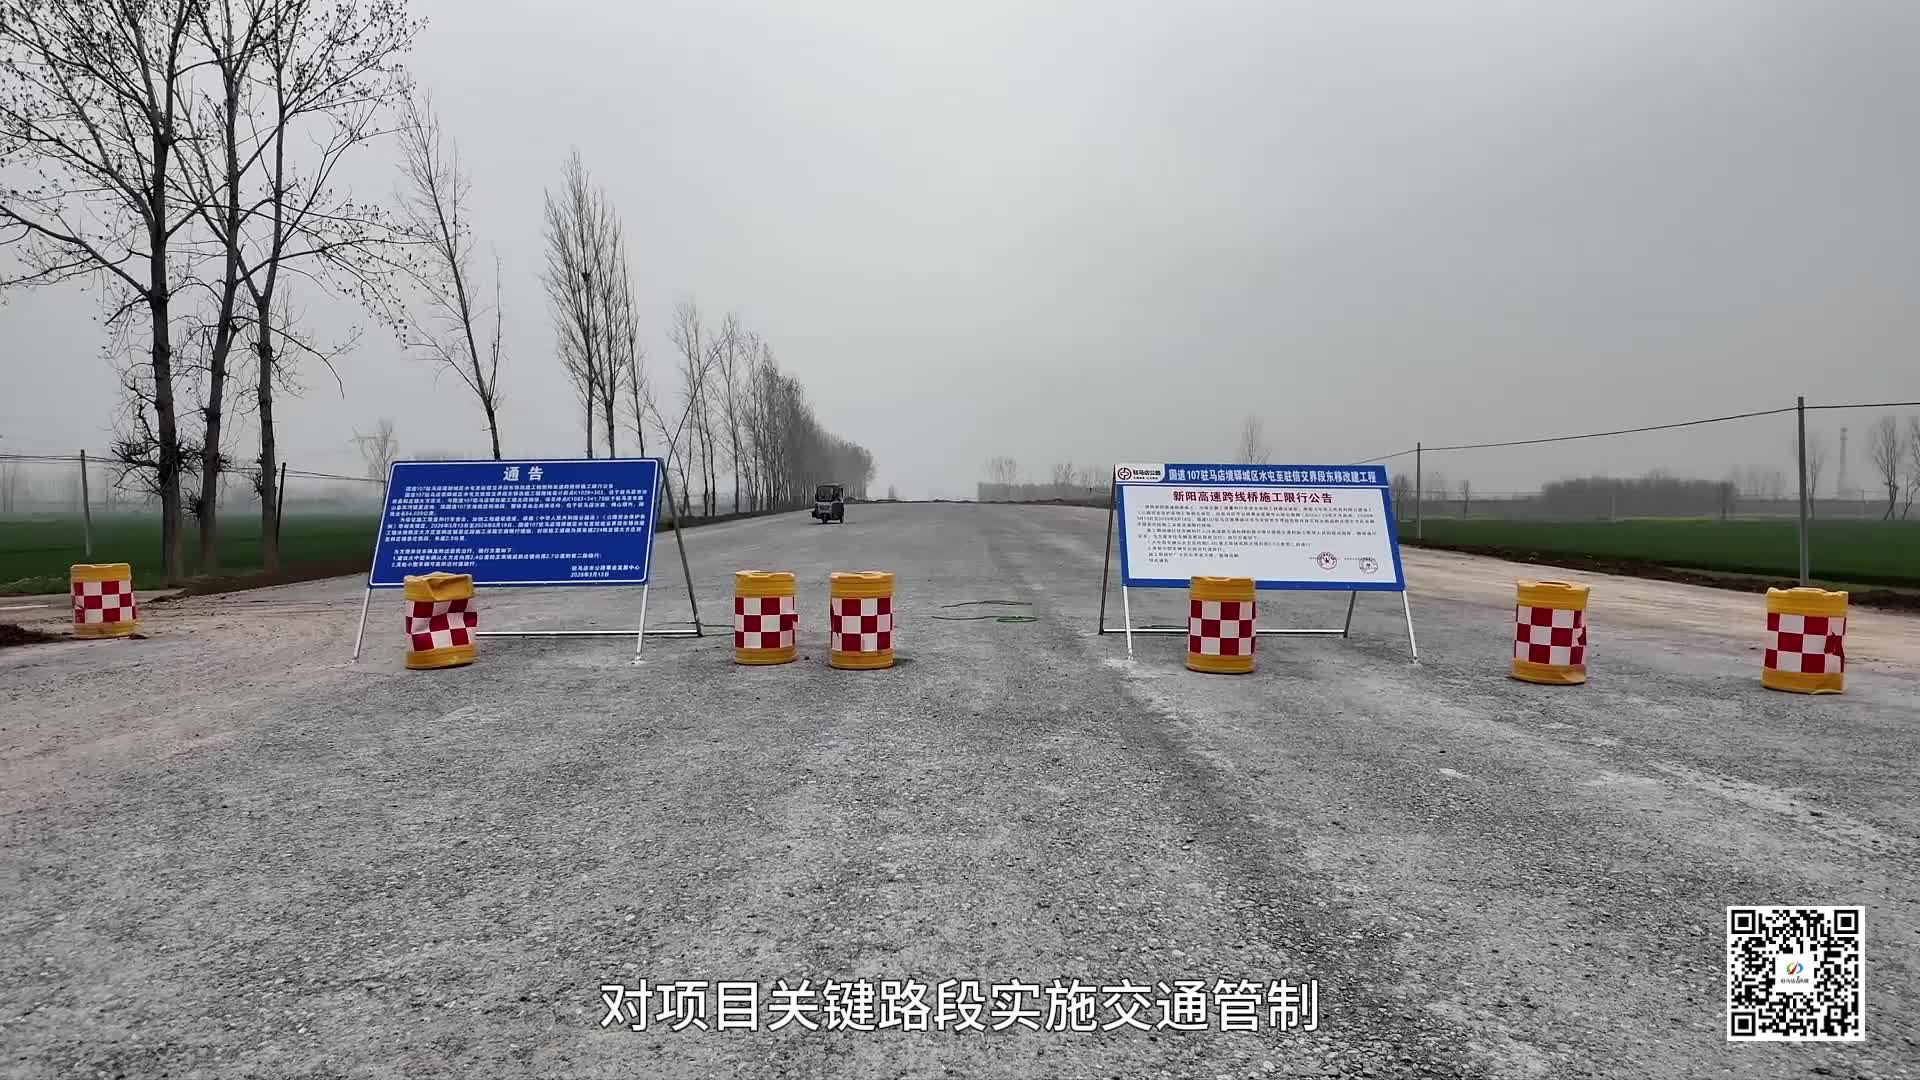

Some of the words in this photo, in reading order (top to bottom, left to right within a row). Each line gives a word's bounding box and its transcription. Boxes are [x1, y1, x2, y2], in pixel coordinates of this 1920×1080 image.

[503, 466, 544, 482] 通告
[1172, 490, 1333, 504] 新阳高速跨线桥施工限行公告
